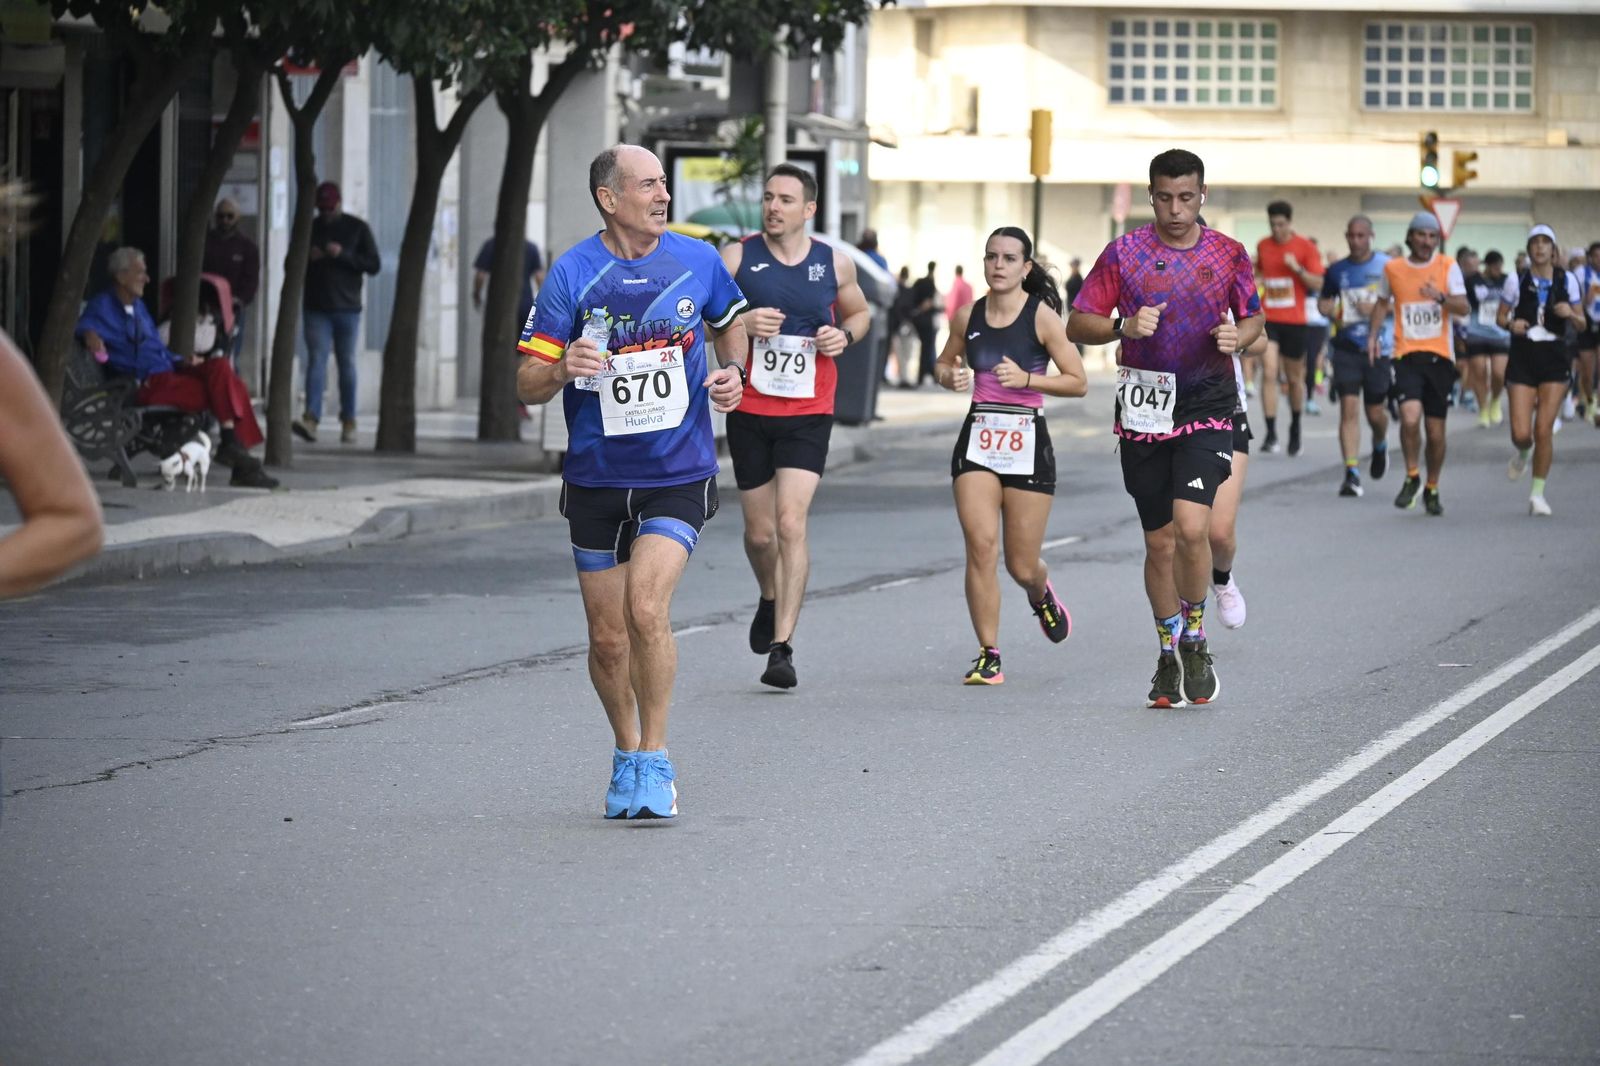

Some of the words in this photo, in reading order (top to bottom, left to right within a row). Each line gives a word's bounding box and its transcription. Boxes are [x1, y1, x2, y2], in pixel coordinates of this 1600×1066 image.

[1406, 310, 1440, 326] 1095
[659, 349, 678, 363] 2K
[764, 350, 806, 375] 979
[612, 370, 672, 405] 670
[1157, 374, 1171, 386] 2K
[1118, 384, 1172, 411] 1047
[625, 414, 663, 427] Huelva
[979, 428, 1023, 452] 978
